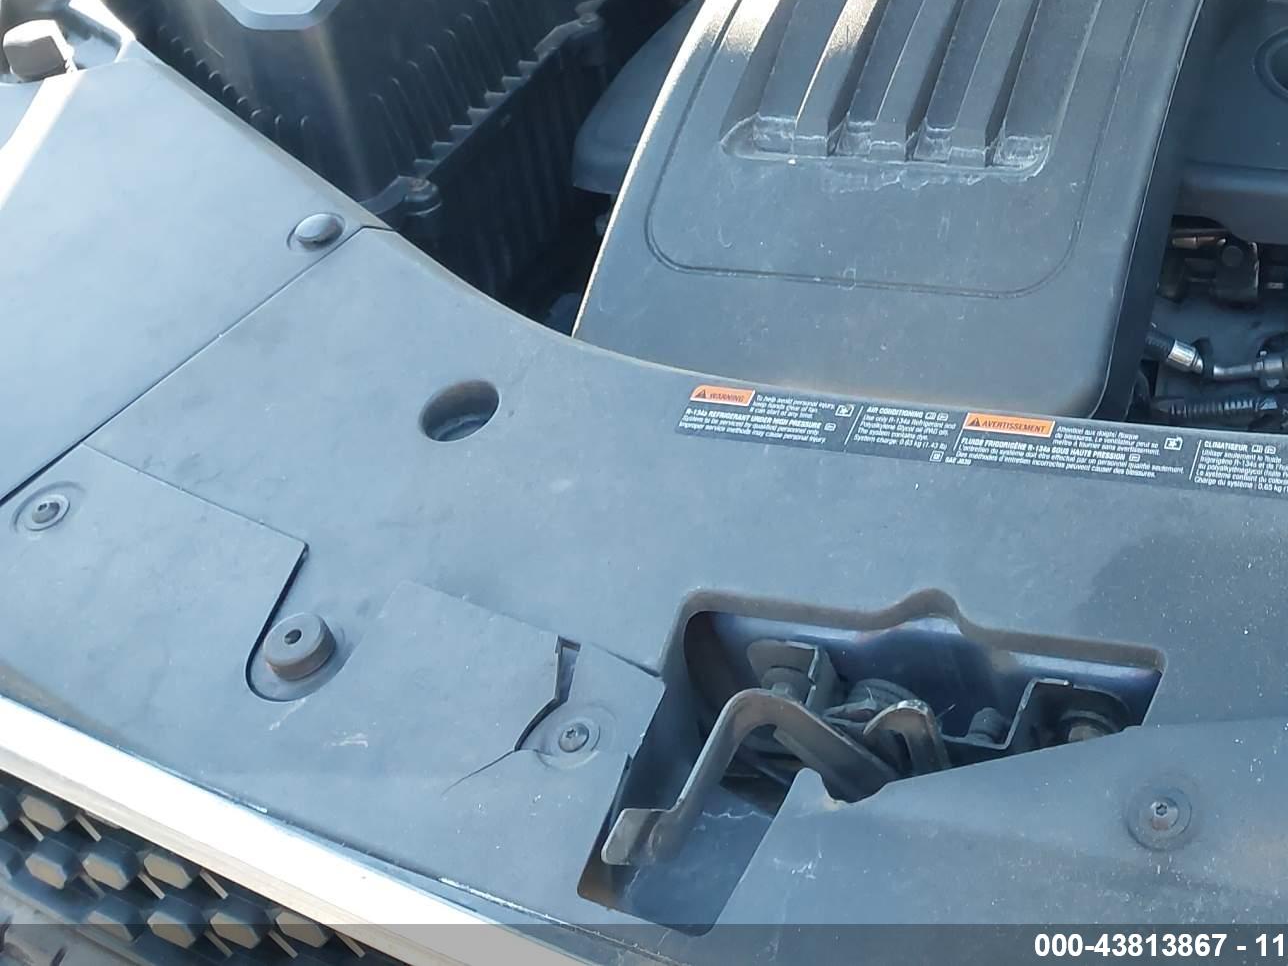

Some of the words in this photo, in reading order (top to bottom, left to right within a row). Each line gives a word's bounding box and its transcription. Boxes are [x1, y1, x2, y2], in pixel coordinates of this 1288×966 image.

[709, 392, 743, 402] WARNING
[793, 399, 817, 408] personal
[686, 408, 707, 417] R-134a
[708, 411, 749, 421] REFRIGERANT
[750, 415, 771, 423] UNDER
[773, 417, 788, 425] HIGH
[789, 419, 821, 428] PRESSURE
[879, 407, 923, 418] CONDITIONING
[679, 421, 703, 430] Improper
[705, 424, 725, 432] service
[726, 426, 750, 435] methods
[765, 430, 782, 438] cause
[783, 432, 808, 441] personal
[982, 420, 1045, 433] AVERTISSEMENT
[853, 434, 875, 442] System
[961, 438, 983, 446] FLUIDE
[1027, 444, 1050, 453] R-134a
[1070, 449, 1091, 457] HAUTE
[1092, 451, 1125, 460] PRESSION
[1204, 441, 1247, 451] CLIMATISEUR
